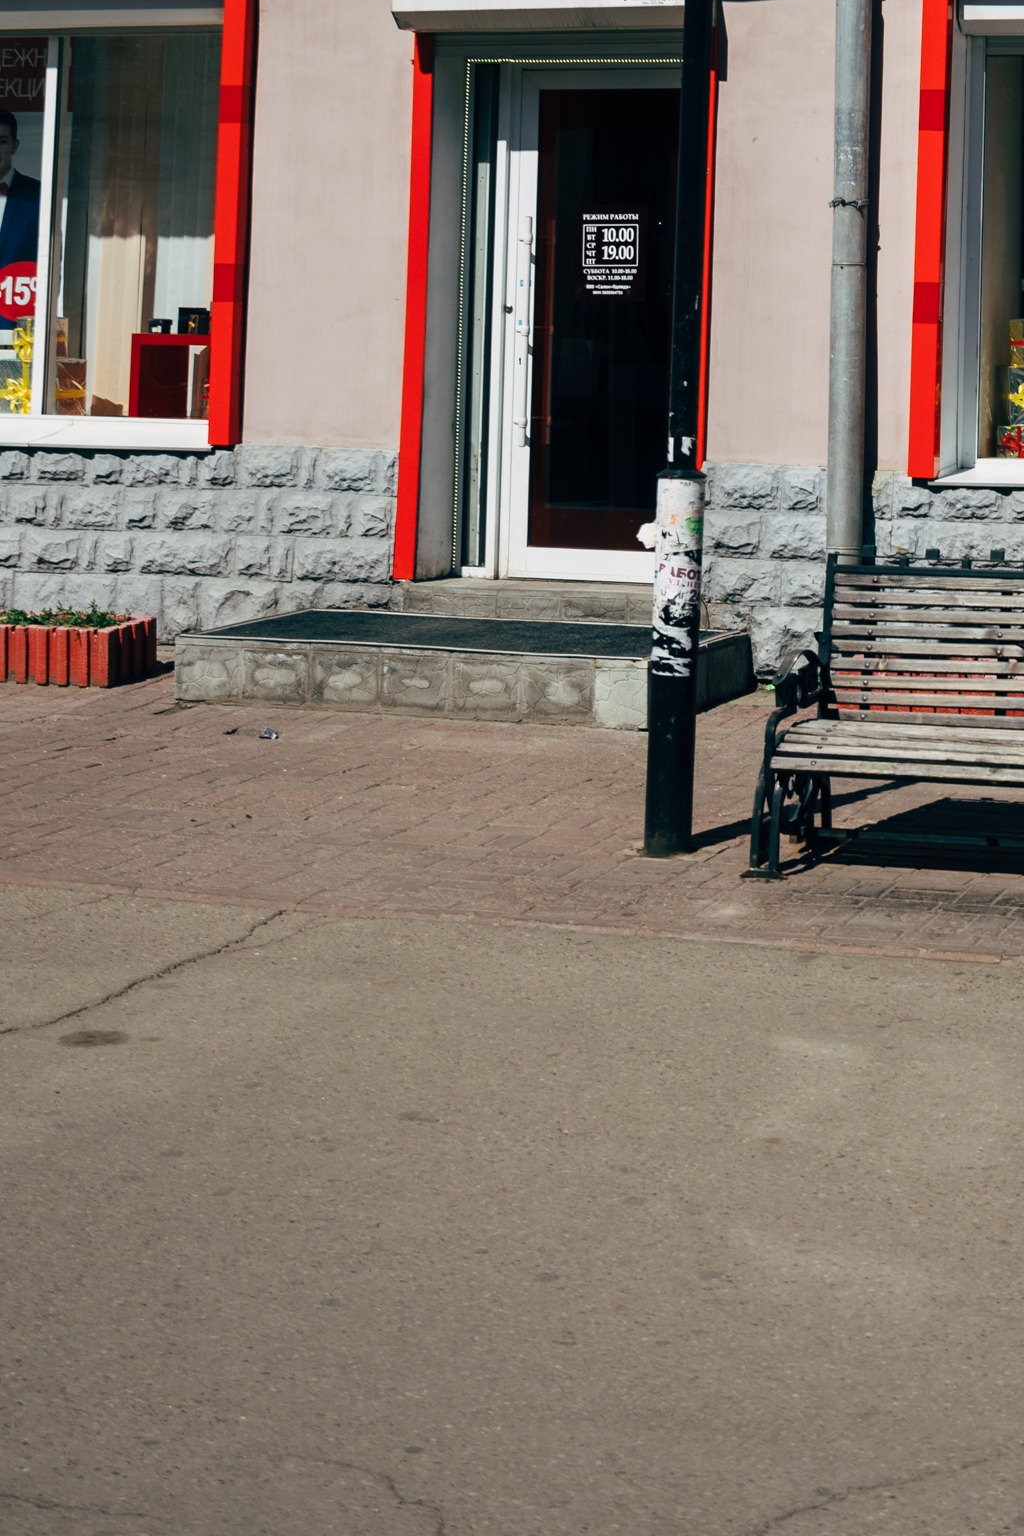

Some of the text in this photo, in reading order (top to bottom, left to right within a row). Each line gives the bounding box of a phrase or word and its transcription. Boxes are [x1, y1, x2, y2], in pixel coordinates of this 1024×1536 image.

[583, 213, 639, 221] РЕЖИМ РАБОТЫ
[601, 227, 634, 243] 10.00
[601, 245, 634, 260] 19.00
